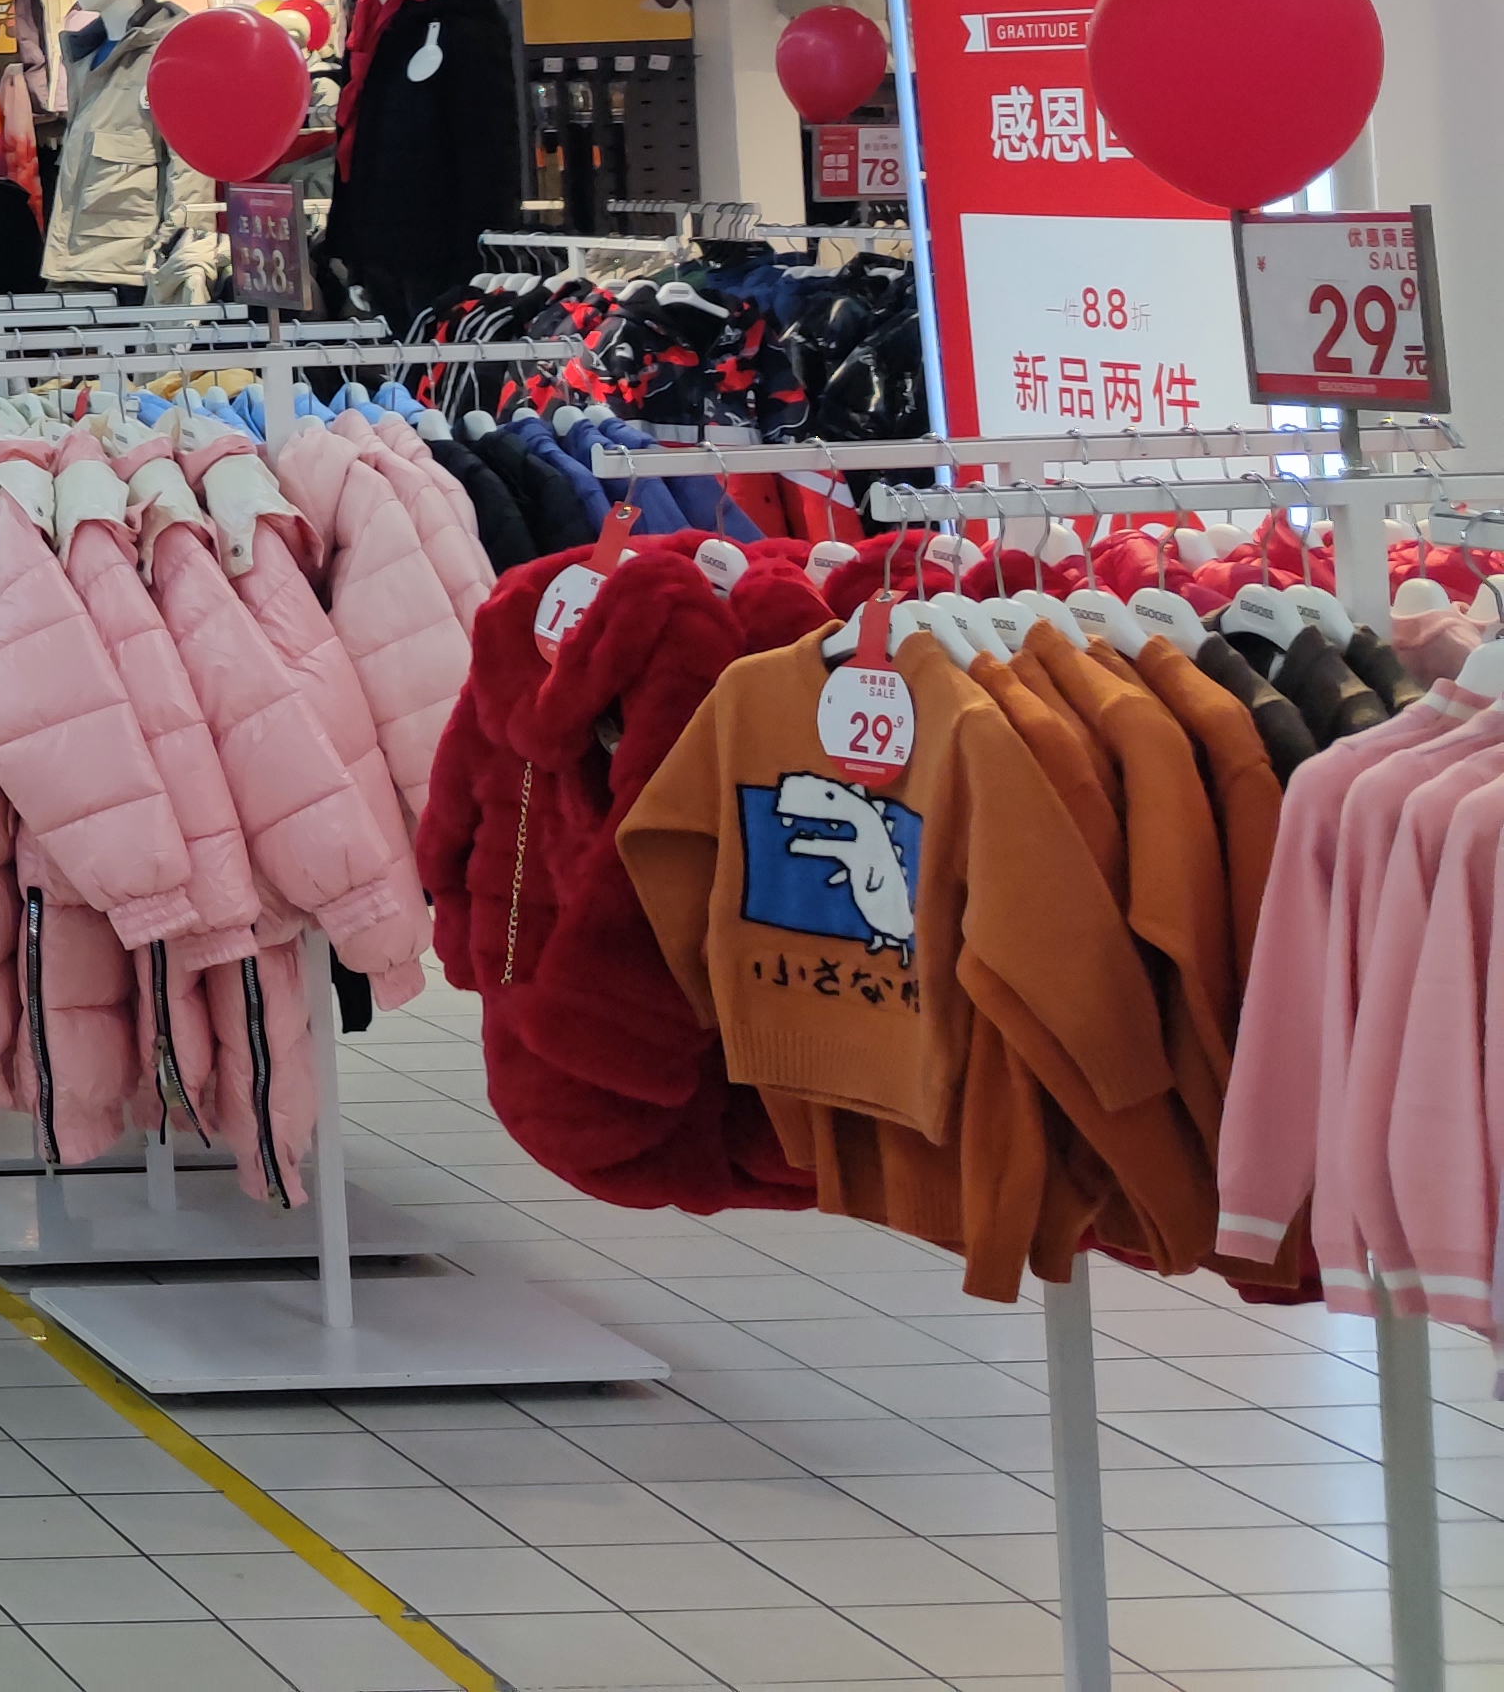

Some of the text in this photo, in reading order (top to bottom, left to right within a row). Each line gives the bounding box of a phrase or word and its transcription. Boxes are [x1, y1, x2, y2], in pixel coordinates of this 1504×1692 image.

[996, 22, 1079, 41] GRATITUDE
[1369, 251, 1418, 271] SALE
[1404, 345, 1428, 376] 元
[1011, 353, 1200, 426] 新品两件
[870, 686, 896, 699] SALE
